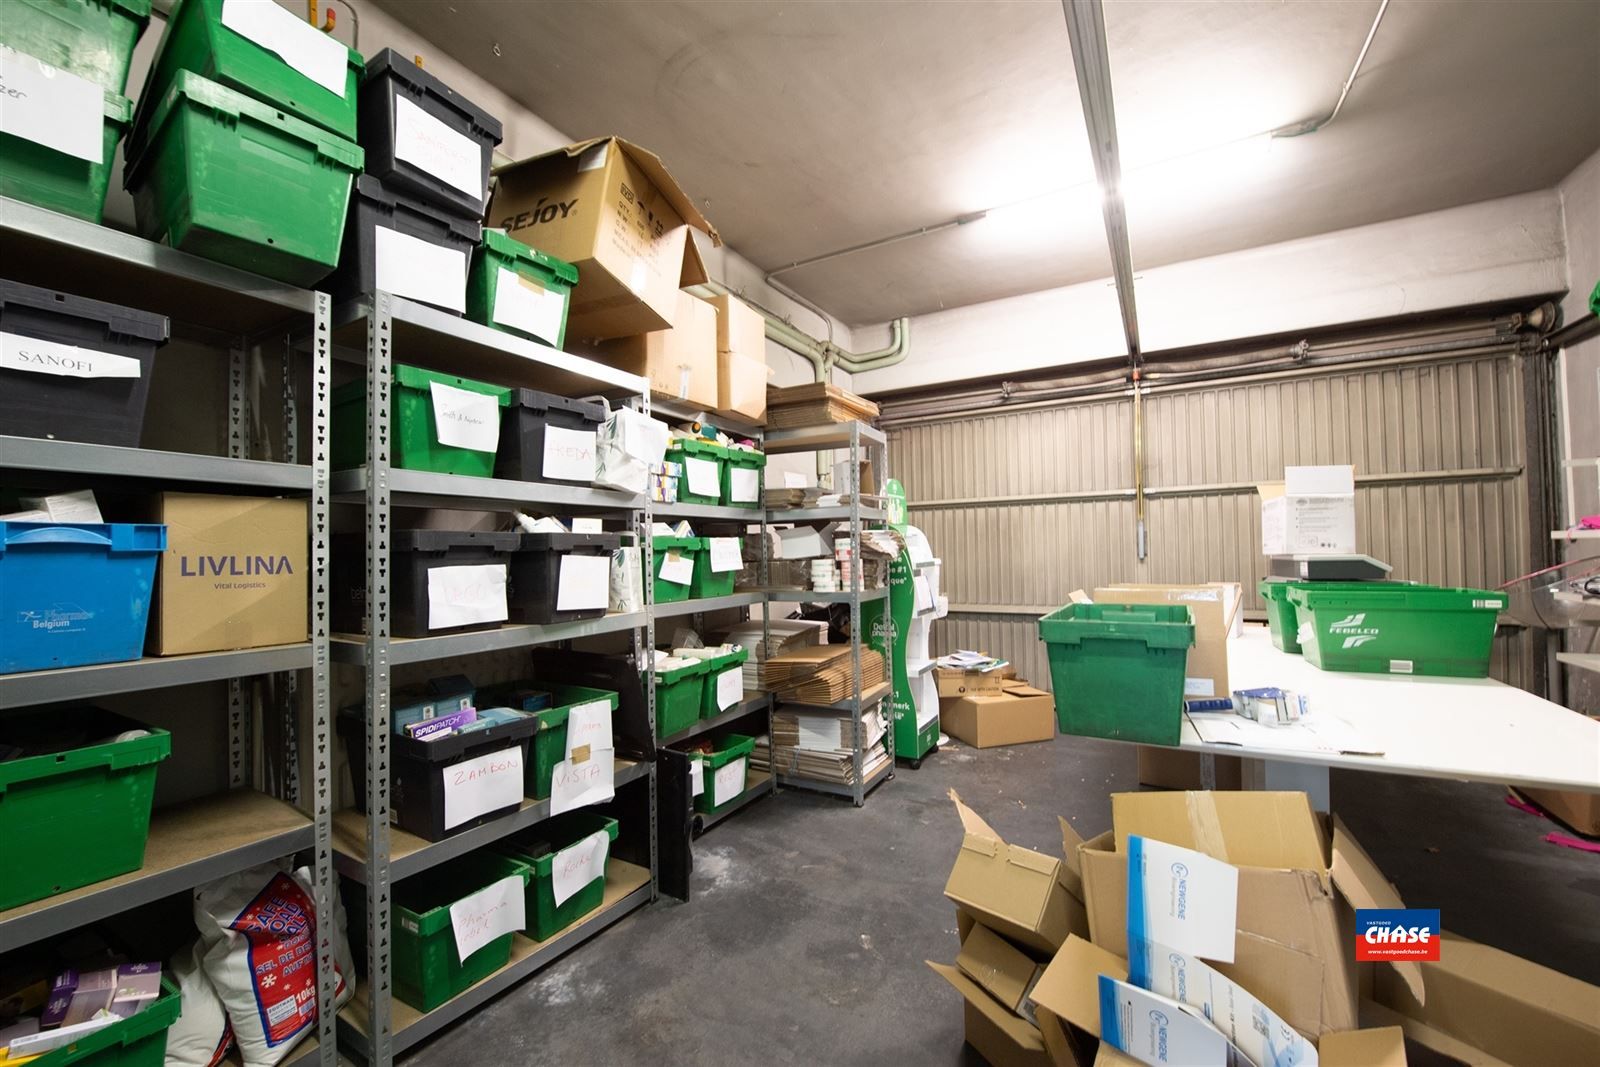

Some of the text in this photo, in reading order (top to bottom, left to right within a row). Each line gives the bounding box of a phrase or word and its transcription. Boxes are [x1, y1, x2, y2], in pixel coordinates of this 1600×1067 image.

[0, 83, 28, 99] zer
[501, 197, 579, 233] SEJOY
[18, 350, 92, 372] SANOFI
[181, 556, 294, 577] LIVLINA
[214, 582, 267, 590] Vital Logistics
[33, 620, 70, 629] Belgium
[1329, 627, 1379, 635] FEBELCO
[415, 715, 462, 738] SPIDIPATCH
[454, 761, 519, 786] ZAMBON
[1178, 879, 1187, 920] NEWGENE
[269, 901, 301, 932] OAD
[254, 960, 278, 976] SEL
[279, 951, 295, 965] DE
[296, 985, 316, 1004] 10kg
[1178, 968, 1187, 1003] NEWGENE
[1158, 1026, 1167, 1063] NEWGENE
